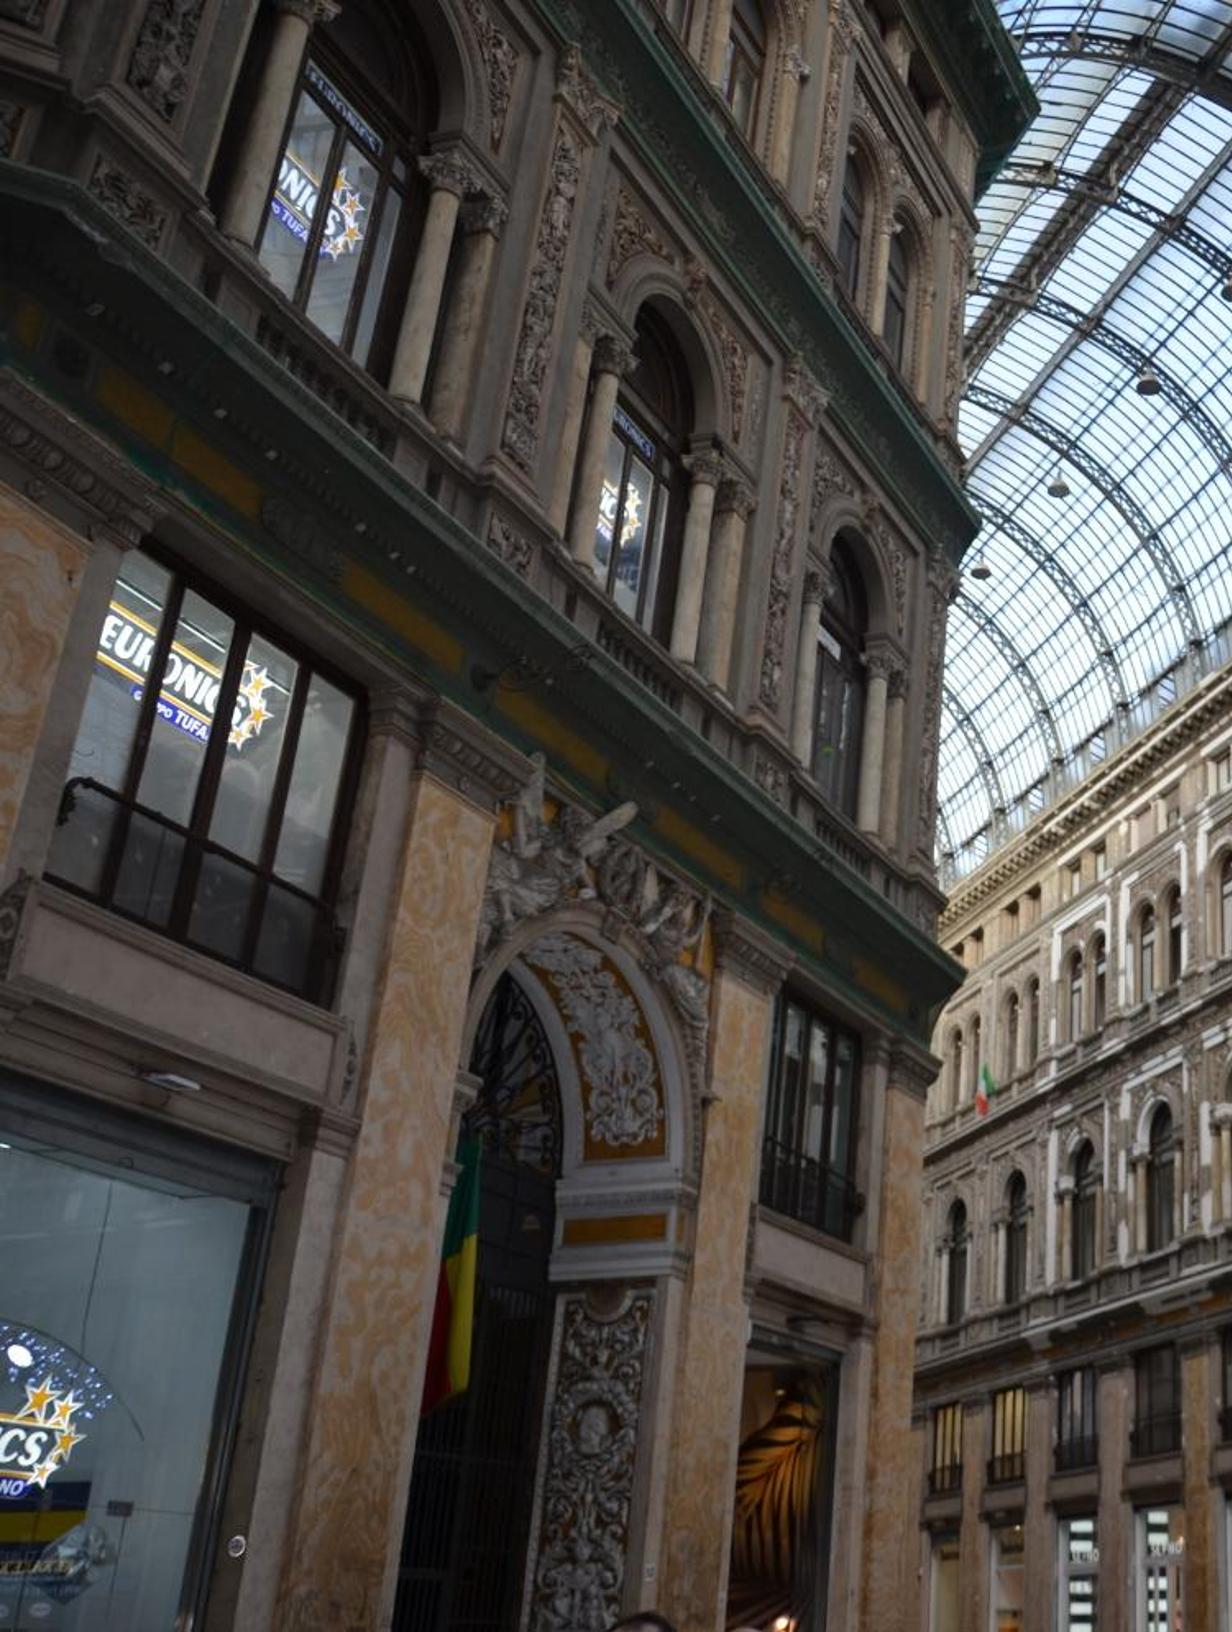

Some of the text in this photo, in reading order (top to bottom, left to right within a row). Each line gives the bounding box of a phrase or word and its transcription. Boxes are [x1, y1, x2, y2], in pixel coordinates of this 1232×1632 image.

[175, 710, 208, 740] TUFA
[0, 1427, 48, 1467] CS
[0, 1479, 24, 1496] NO
